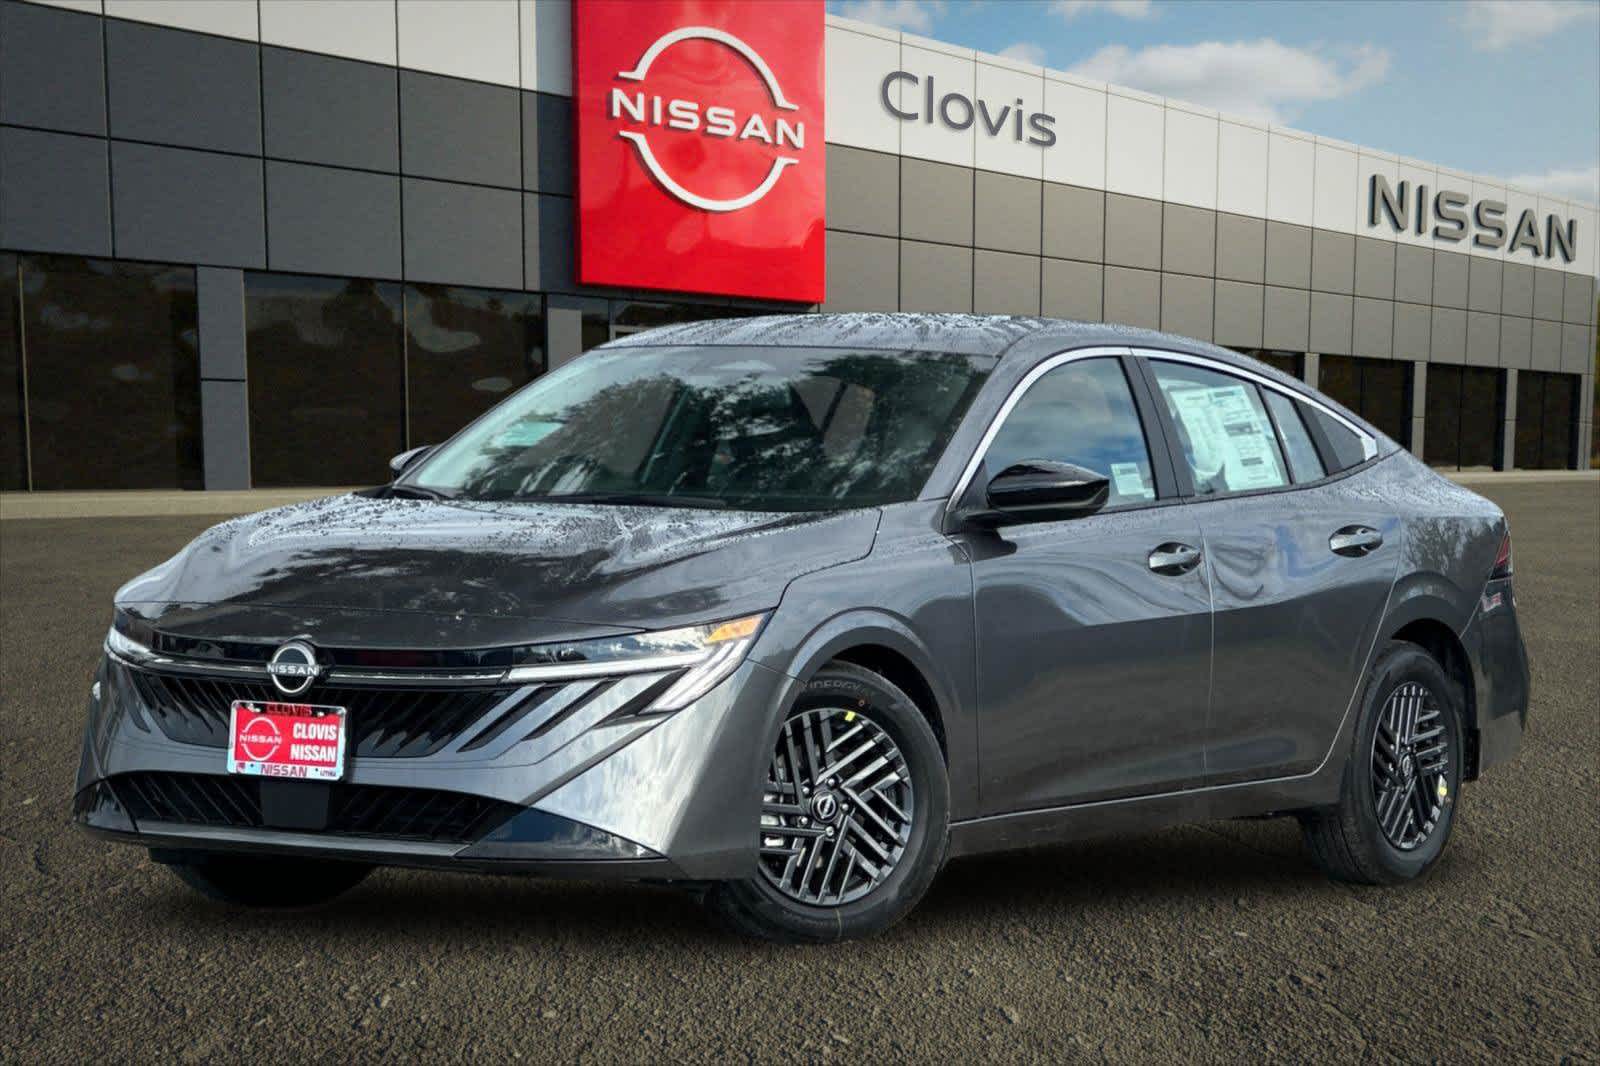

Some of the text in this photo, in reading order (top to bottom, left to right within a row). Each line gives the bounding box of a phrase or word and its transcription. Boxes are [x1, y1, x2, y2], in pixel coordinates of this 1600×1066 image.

[611, 87, 805, 149] NISSAN
[880, 70, 1057, 147] Clovis
[1367, 173, 1578, 263] NISSAN
[267, 663, 320, 676] NISSAN
[240, 734, 282, 745] NISSAN
[292, 722, 337, 740] CLOVIS
[290, 743, 336, 763] NISSAN
[260, 764, 308, 778] NISSAN
